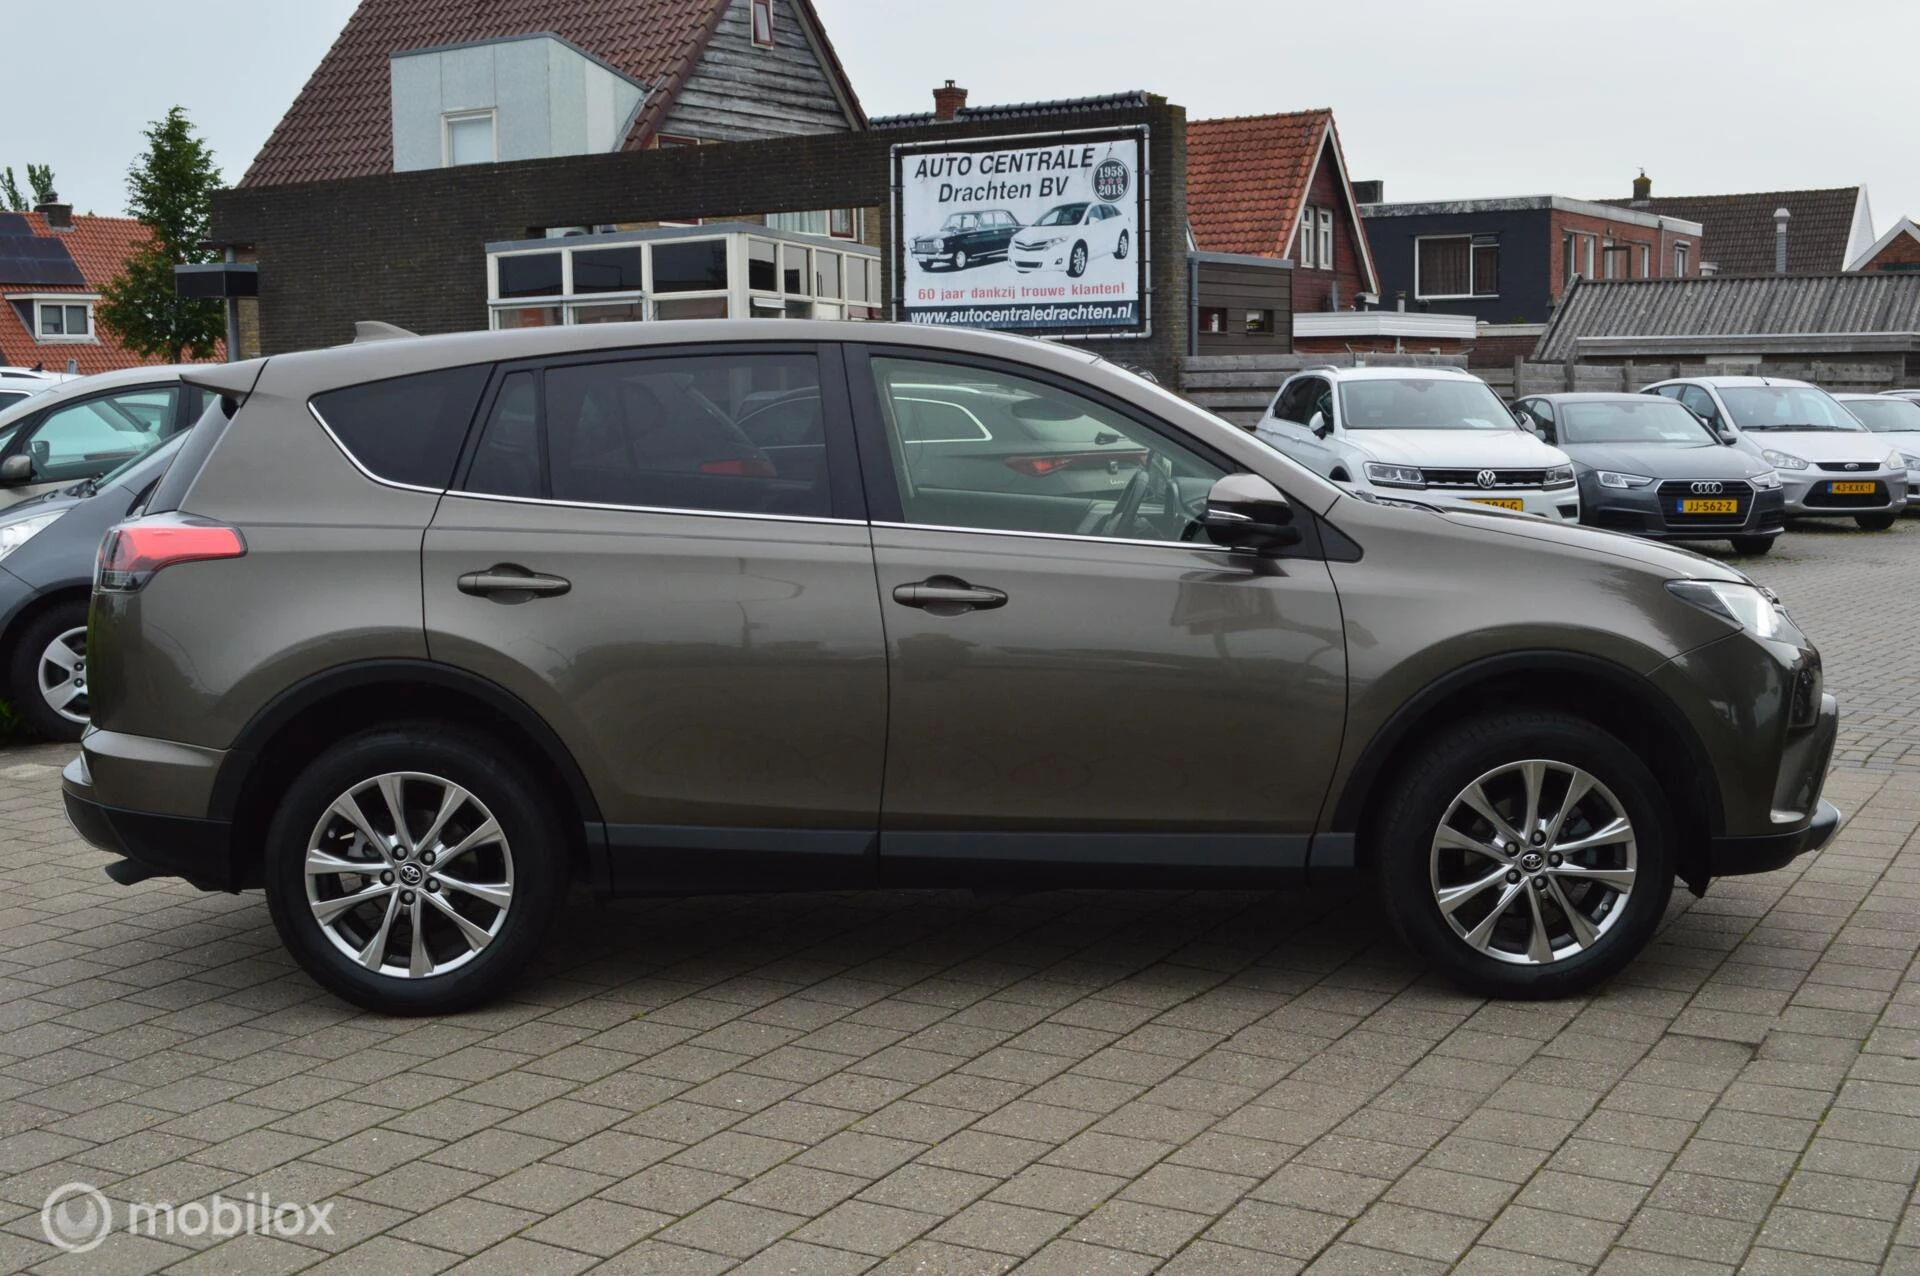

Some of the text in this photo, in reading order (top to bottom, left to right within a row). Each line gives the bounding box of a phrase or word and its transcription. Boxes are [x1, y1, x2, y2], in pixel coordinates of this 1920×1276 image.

[915, 148, 1095, 178] AUTO CENTRALE
[1099, 165, 1124, 178] 1958
[938, 176, 1069, 203] Drachten BV
[1098, 183, 1124, 196] 2018
[918, 282, 1126, 301] 60 jaar dankzij trouwe klanten!
[911, 303, 1132, 324] www.autocentraledrachten.nl
[1687, 501, 1732, 512] JJ-562-Z
